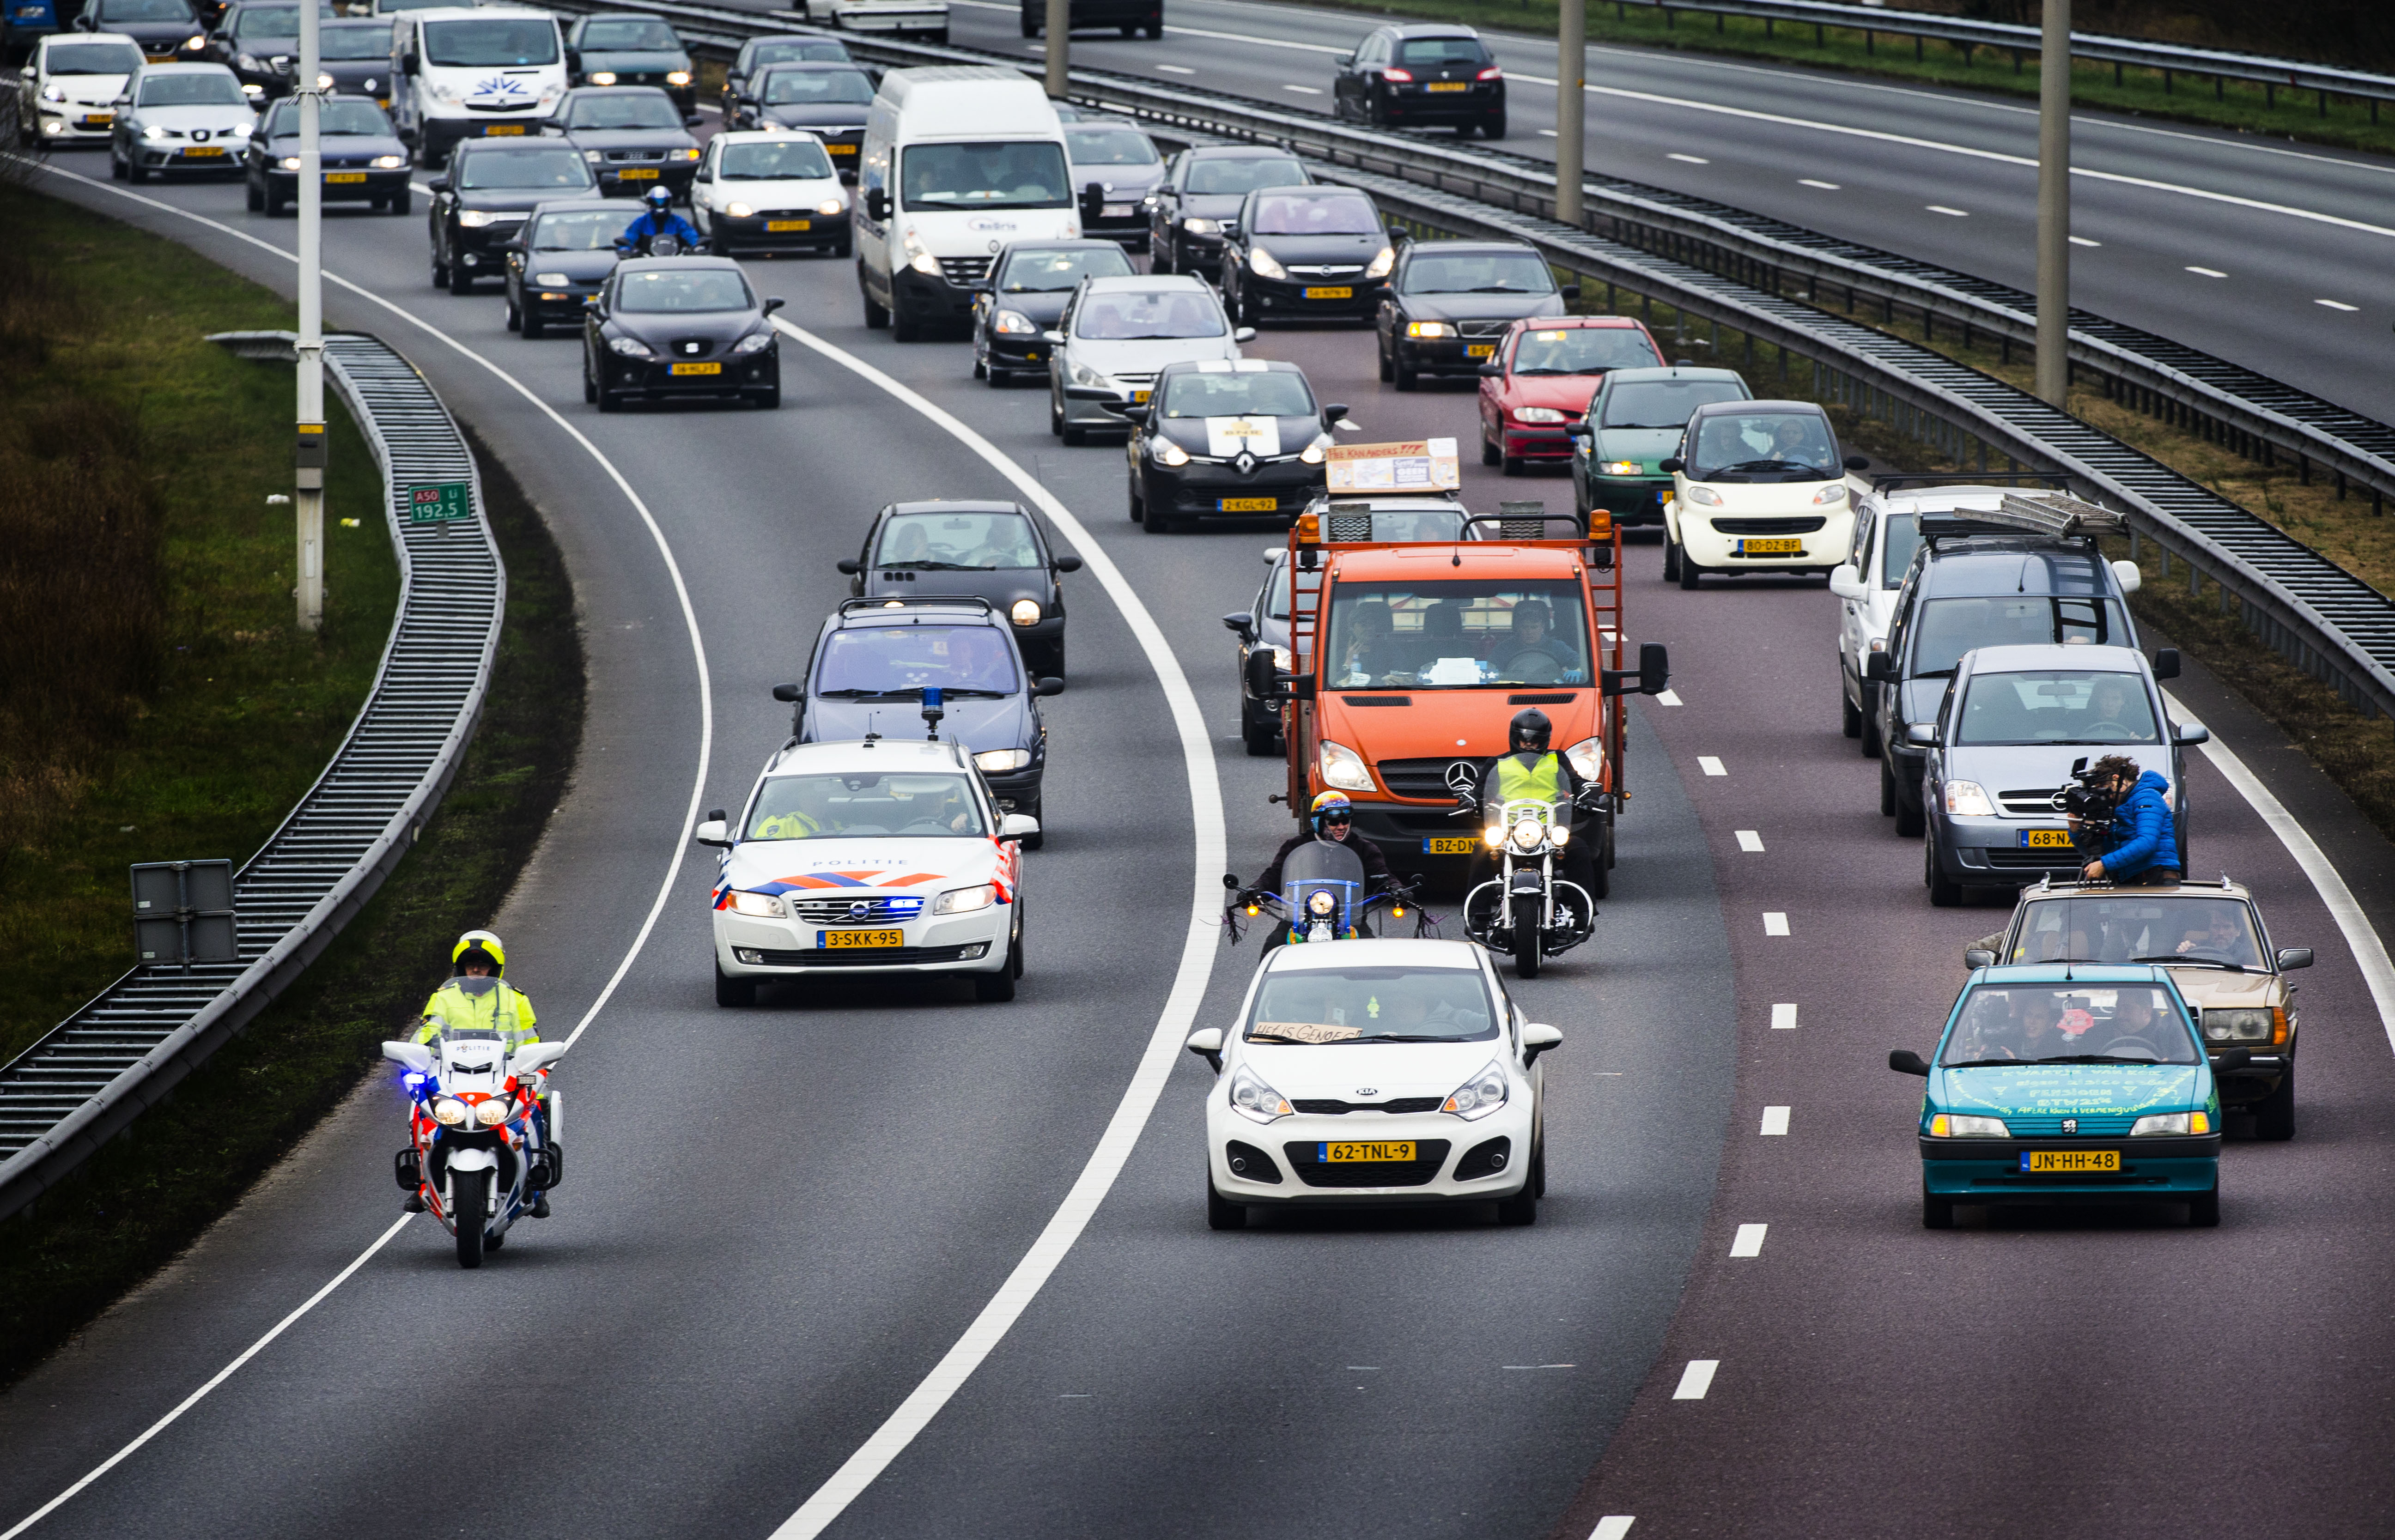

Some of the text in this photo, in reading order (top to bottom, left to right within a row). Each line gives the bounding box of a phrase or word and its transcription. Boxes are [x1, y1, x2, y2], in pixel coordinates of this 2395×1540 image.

[417, 491, 438, 501] A50
[1226, 500, 1272, 509] 2-KGL-92
[1747, 540, 1797, 551] 80-DZ-BF
[830, 932, 898, 946] 3-SKK-95
[1333, 1144, 1409, 1159] 62-TNL-9
[2034, 1153, 2114, 1169] JN-HH-48
